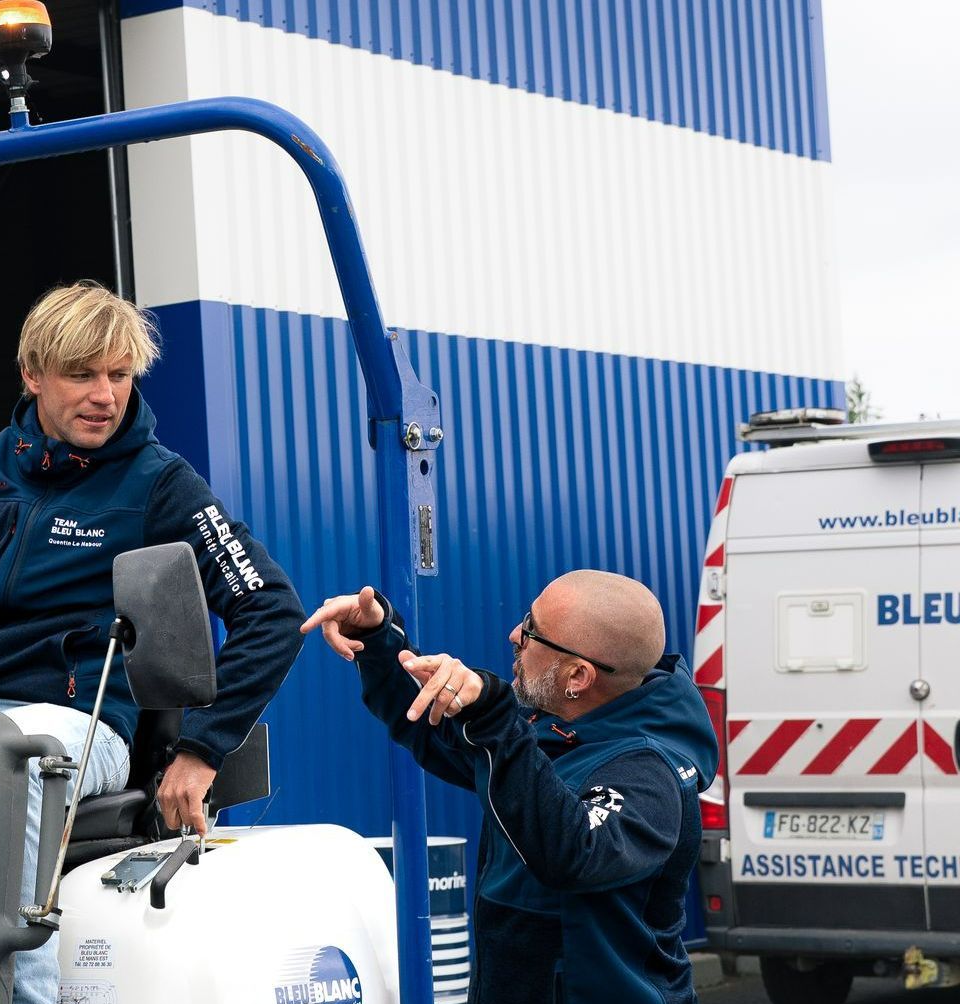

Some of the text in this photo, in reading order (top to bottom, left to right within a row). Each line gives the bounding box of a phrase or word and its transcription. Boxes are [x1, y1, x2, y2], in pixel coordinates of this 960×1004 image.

[54, 517, 78, 528] TEAM
[819, 507, 960, 529] www.bleubl
[48, 538, 71, 546] Quentin
[51, 526, 105, 537] BLEU BLANC
[877, 592, 960, 625] BLEU
[741, 855, 960, 878] ASSISTANCE TECH
[314, 977, 360, 1003] BLANC
